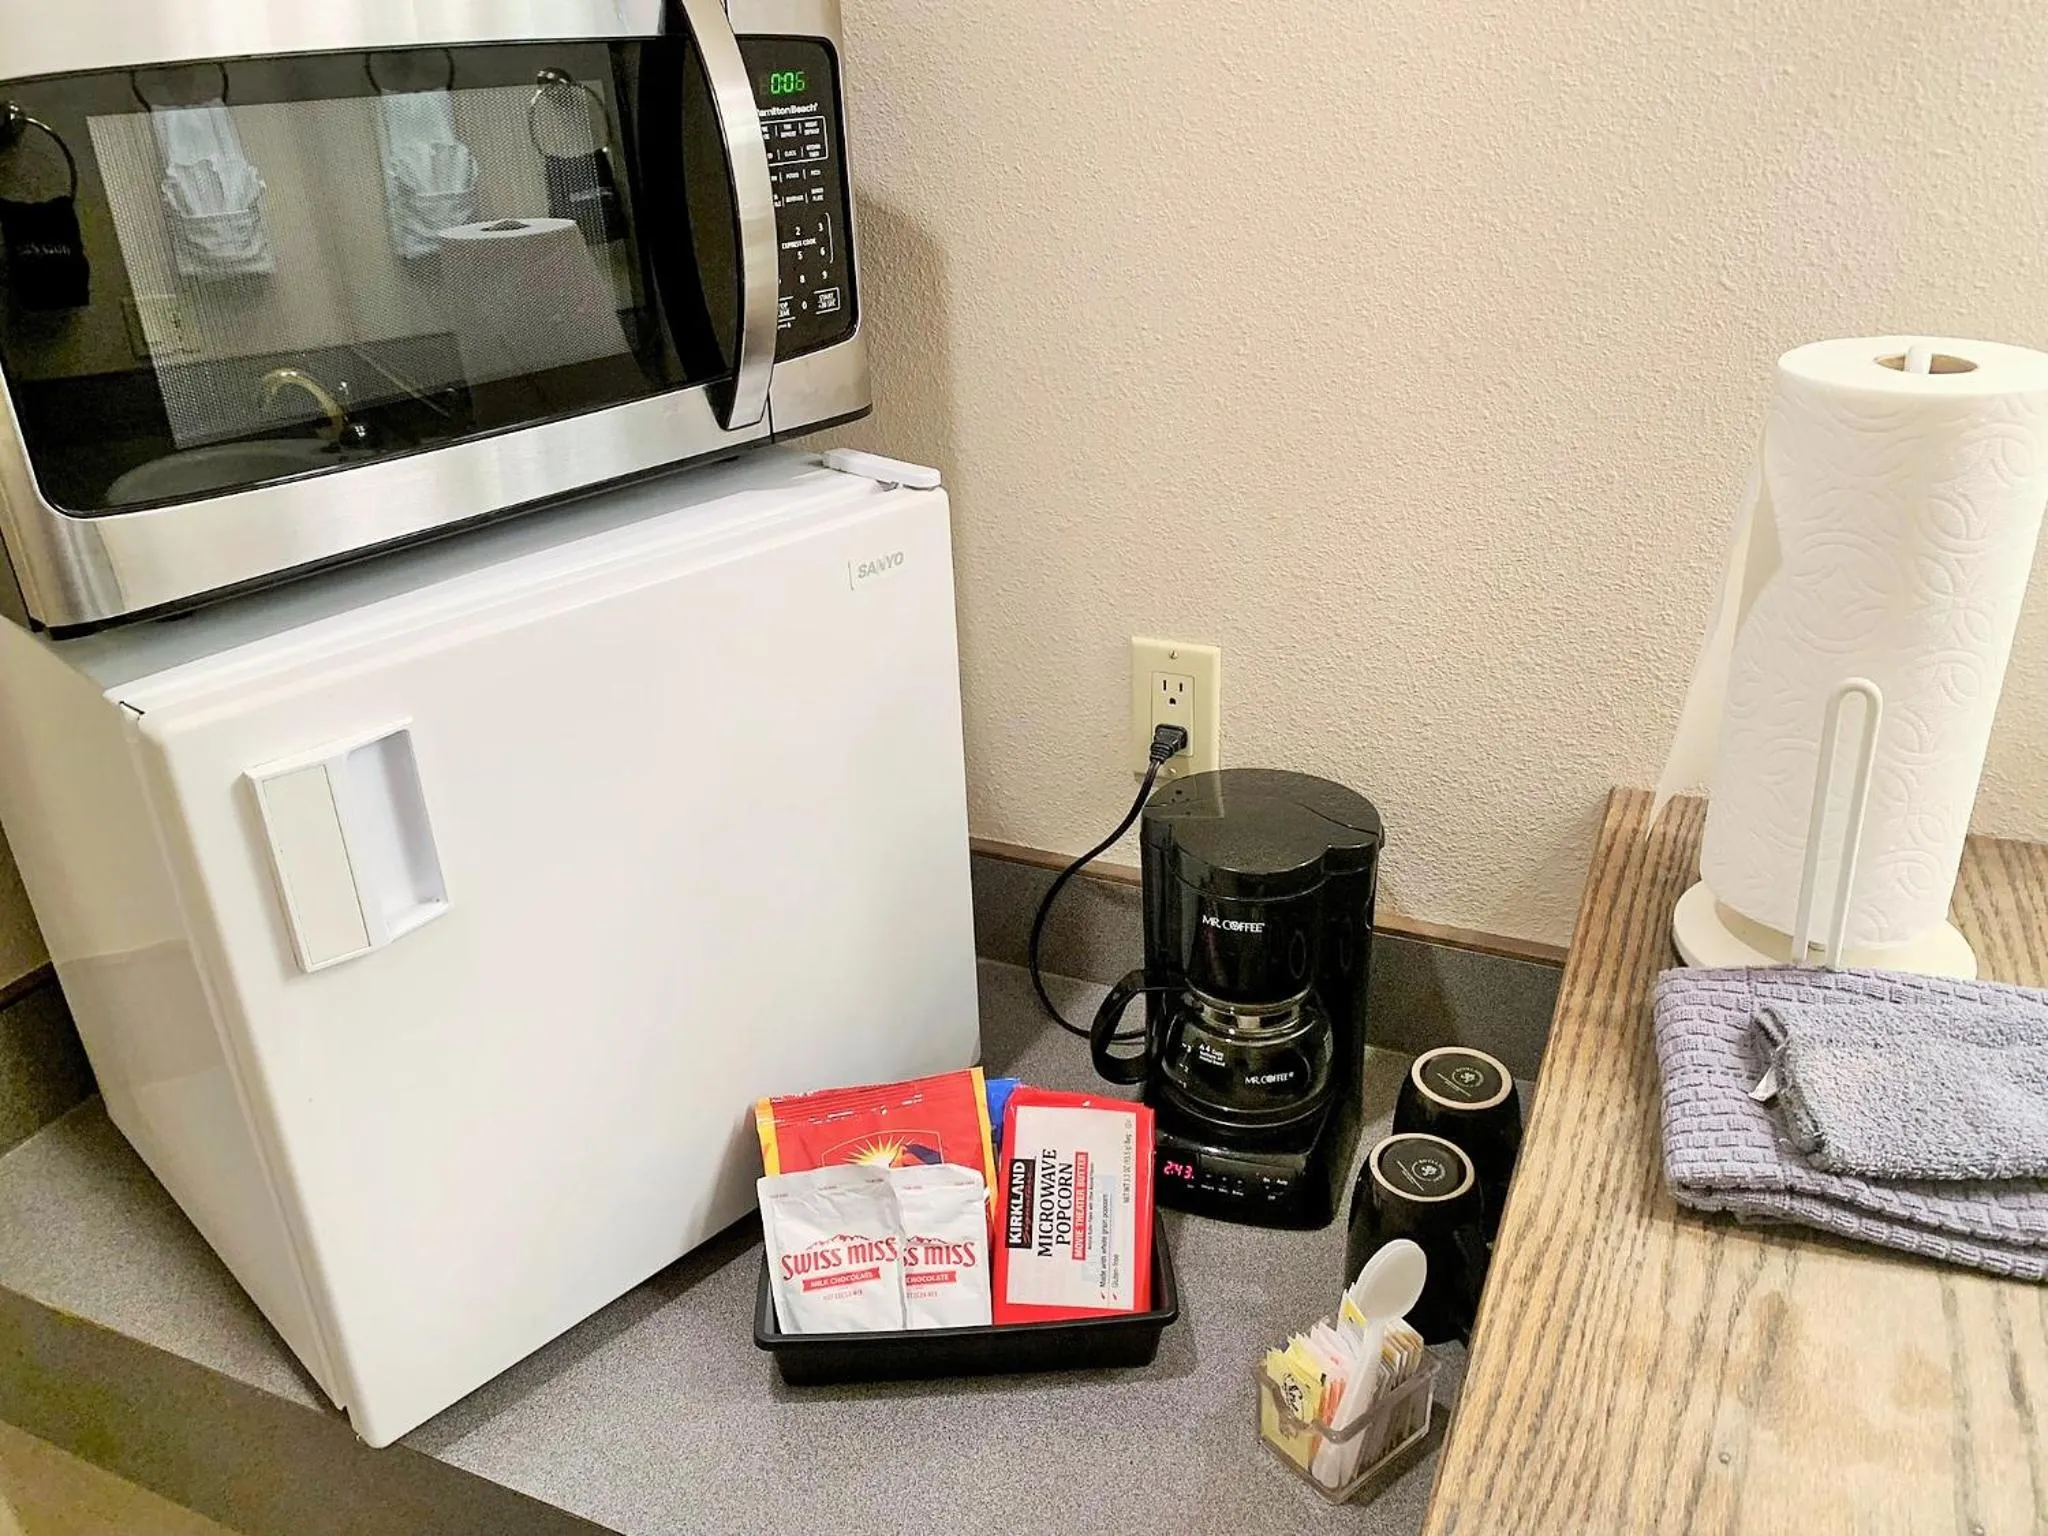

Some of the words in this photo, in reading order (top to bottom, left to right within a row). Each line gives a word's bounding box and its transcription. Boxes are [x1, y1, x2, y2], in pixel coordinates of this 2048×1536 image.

[857, 551, 905, 579] SANYO
[1077, 1155, 1088, 1187] BUTTER
[1008, 1161, 1026, 1244] KIRKLAND
[1037, 1148, 1057, 1257] MICROWAVE
[1055, 1162, 1073, 1246] POPCORN
[1075, 1190, 1086, 1226] THEATER
[1073, 1229, 1085, 1257] MOVIE
[781, 1247, 842, 1280] SWISS
[810, 1279, 829, 1288] MILK
